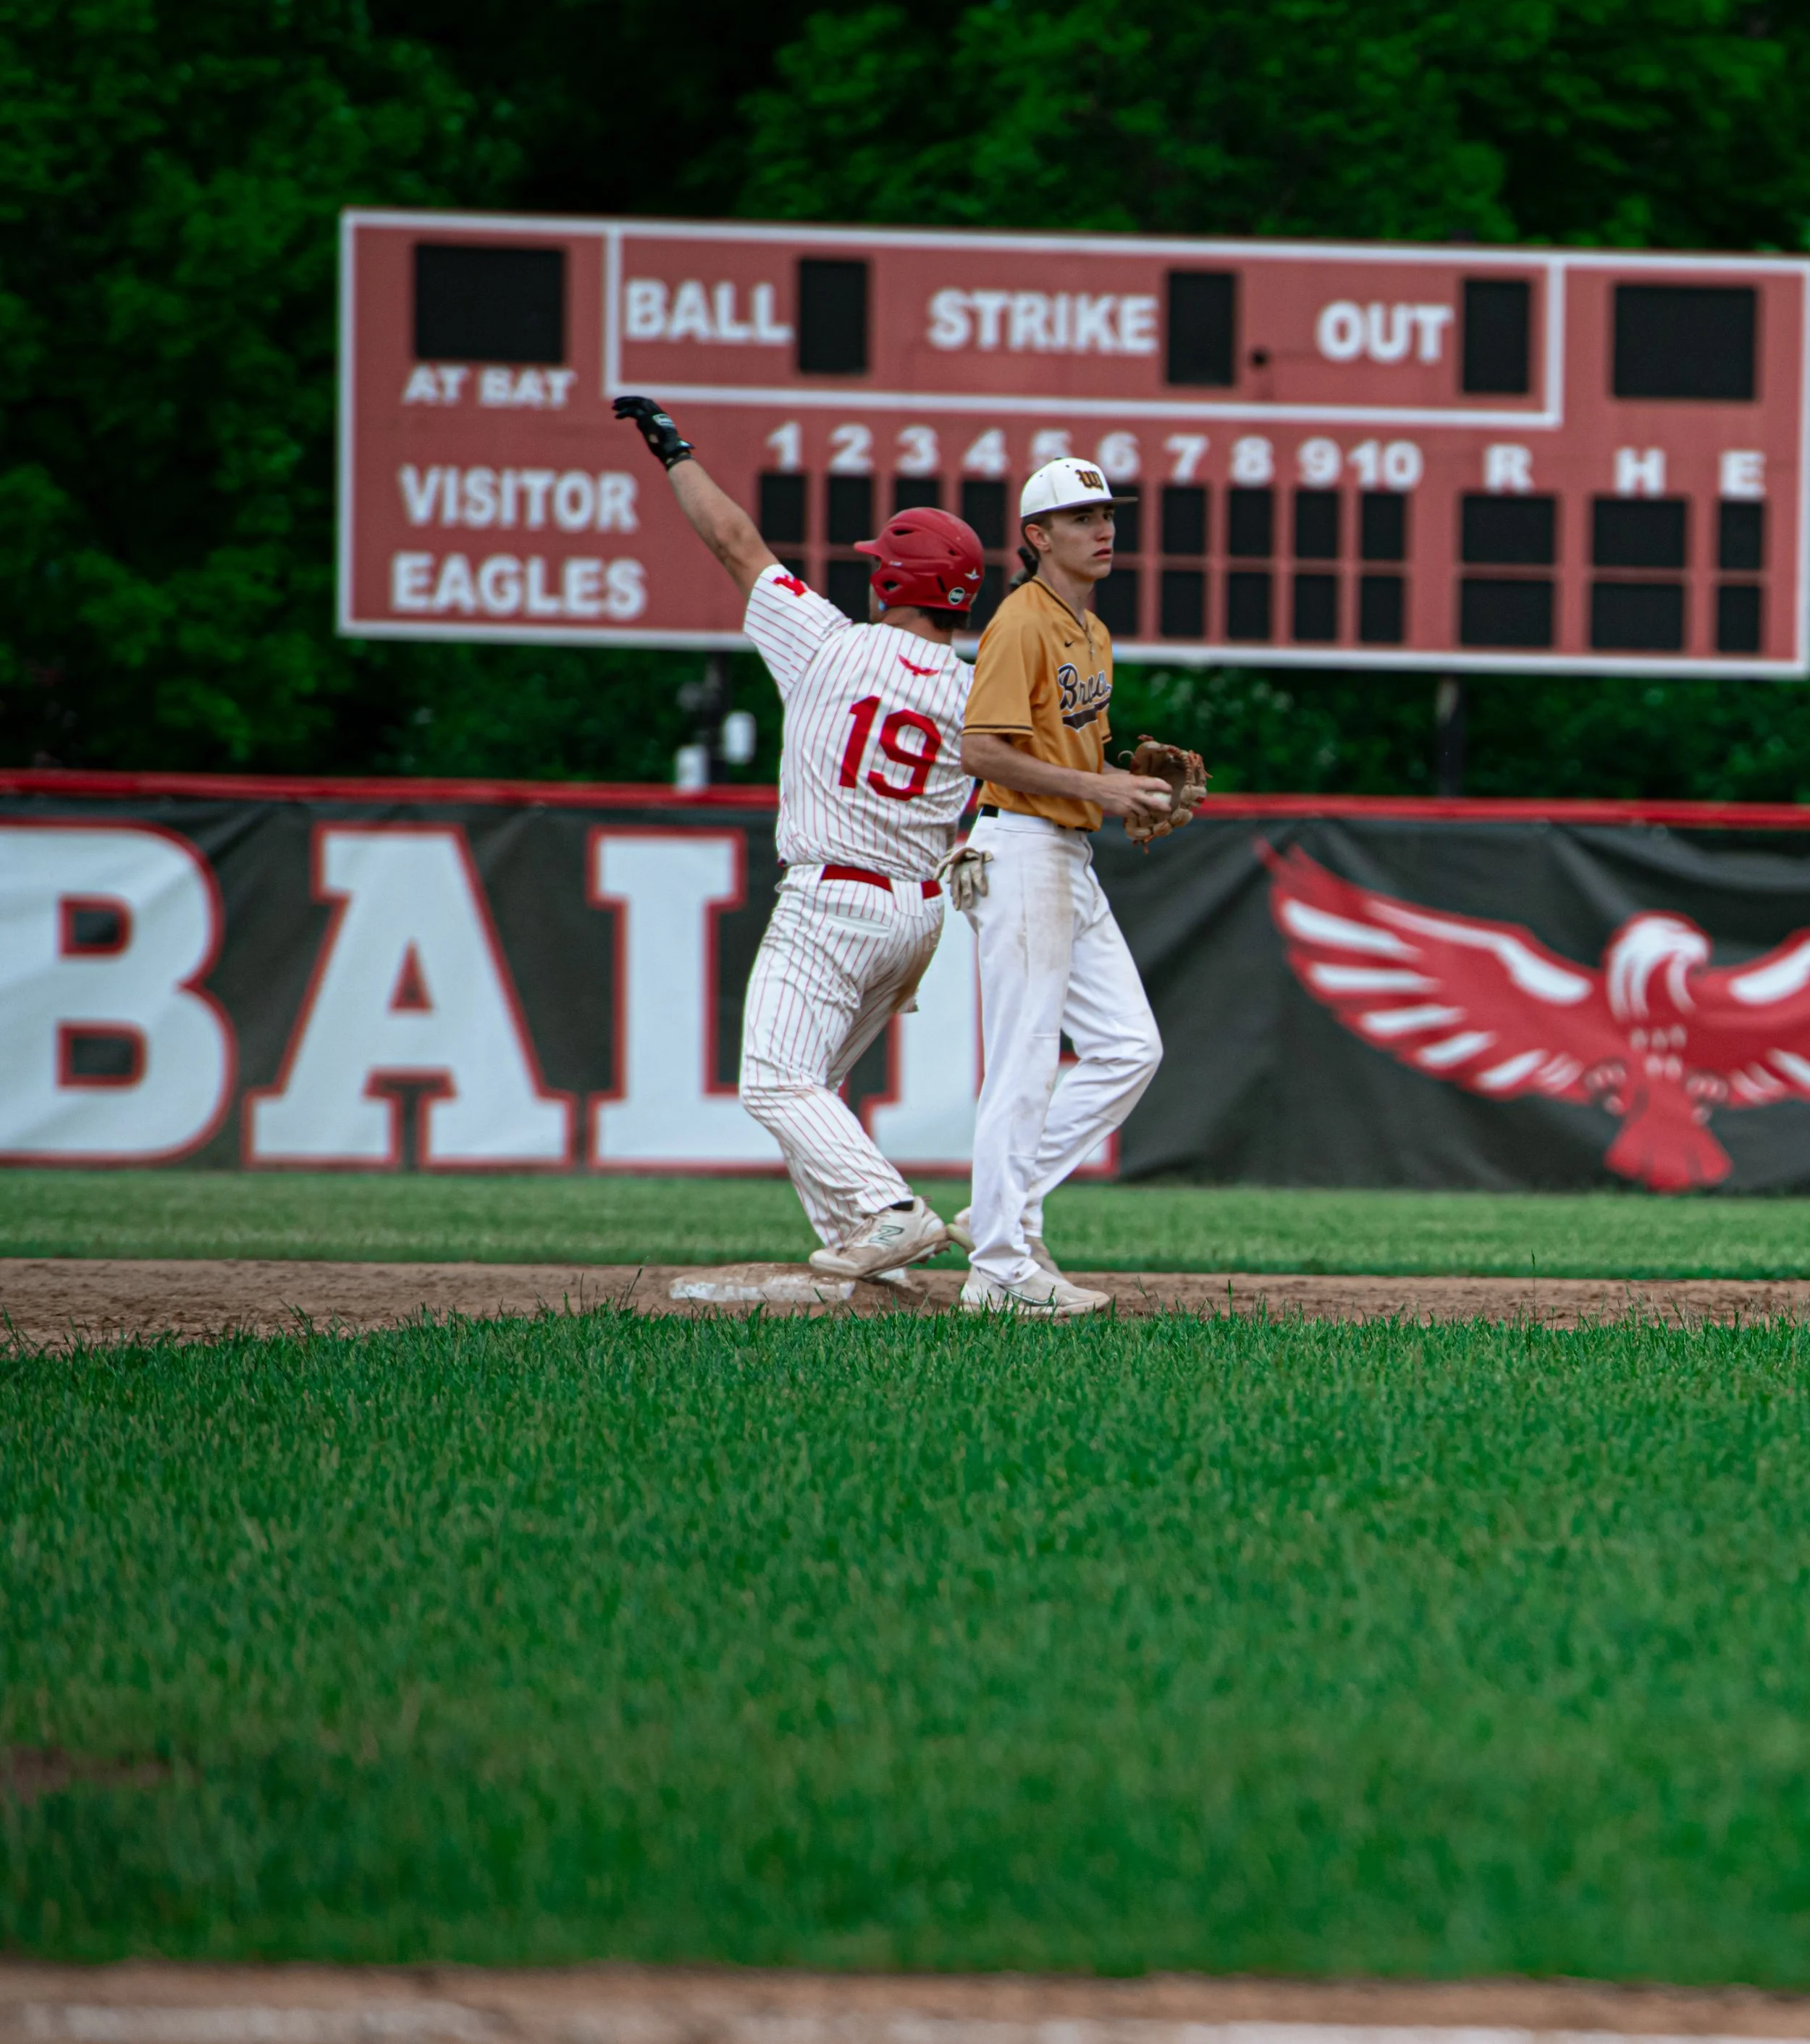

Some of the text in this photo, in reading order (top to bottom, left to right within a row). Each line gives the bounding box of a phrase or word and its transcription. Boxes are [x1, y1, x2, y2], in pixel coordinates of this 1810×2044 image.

[623, 278, 1455, 365] BALL STRIKE OUT
[402, 365, 577, 409] AT BAT
[766, 421, 1767, 500] 1 2 3 4 5 6 7 8 9 10 R H E
[399, 464, 639, 534] VISITOR
[391, 550, 647, 621] EAGLES
[838, 695, 943, 802] 19
